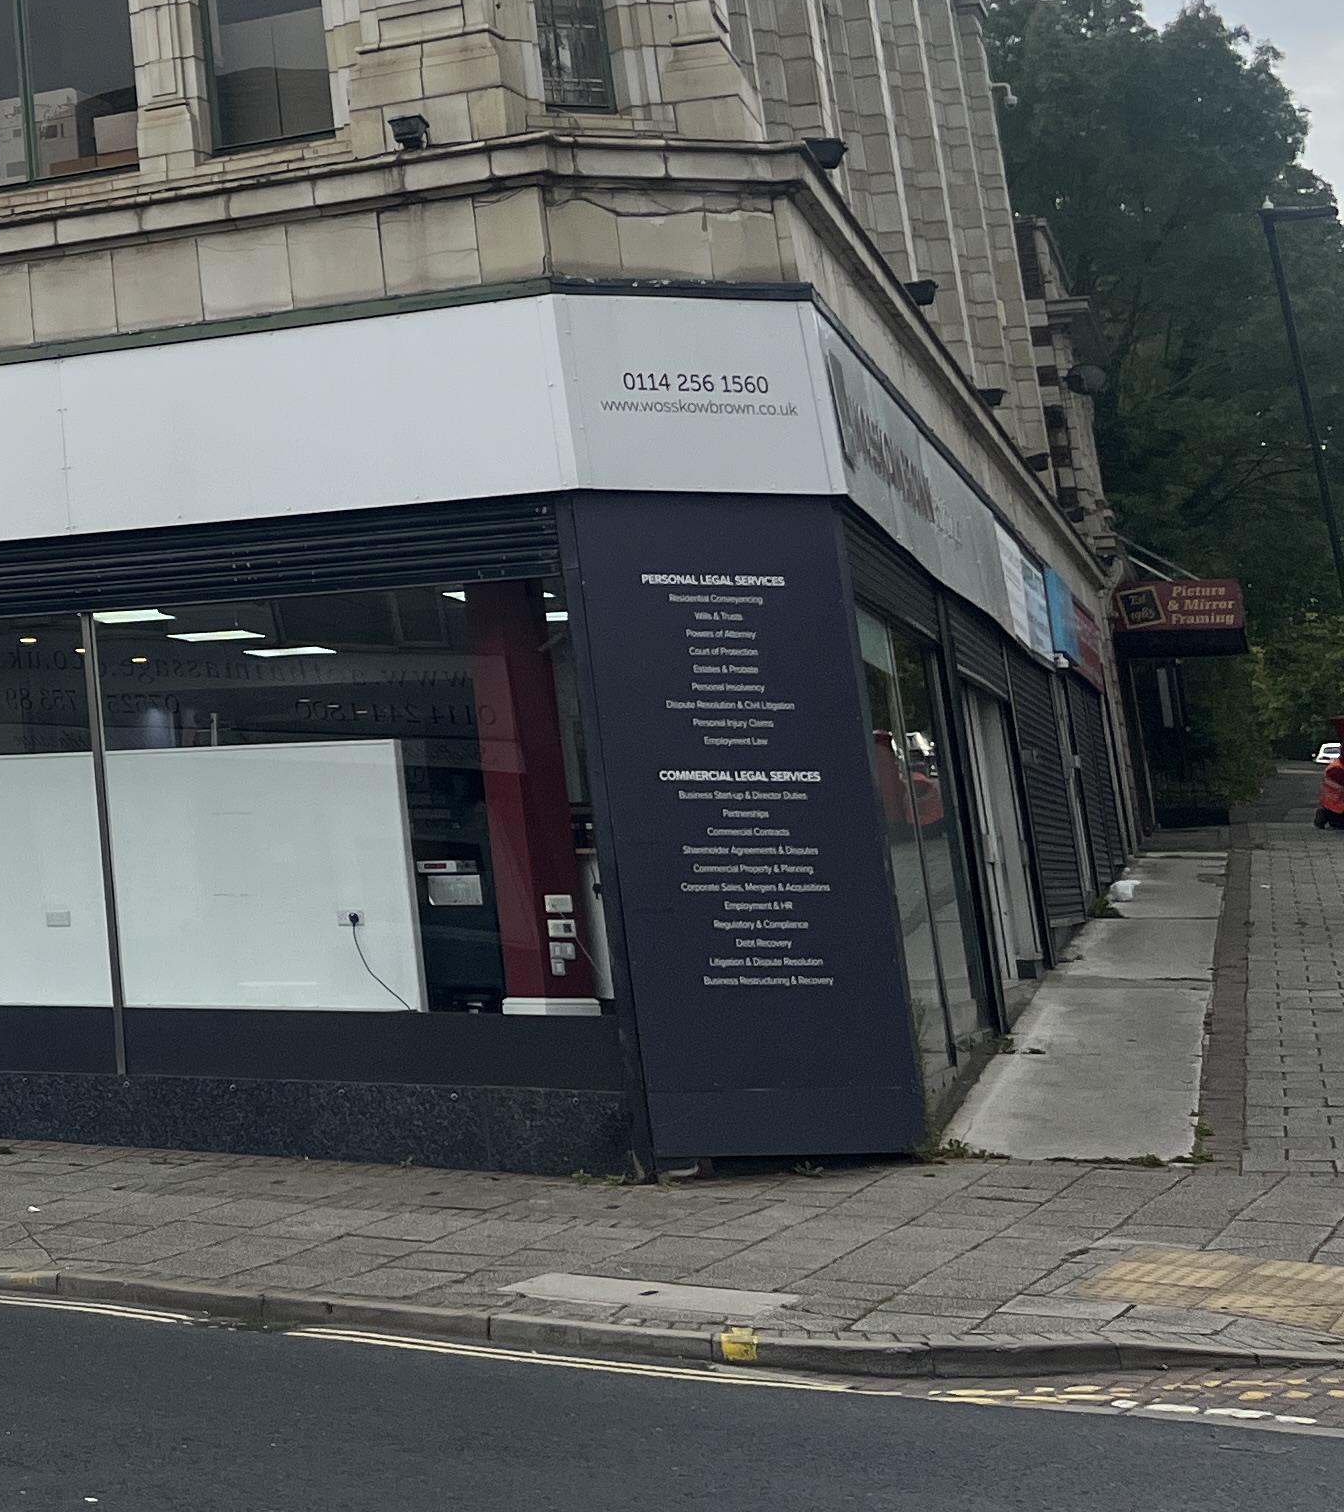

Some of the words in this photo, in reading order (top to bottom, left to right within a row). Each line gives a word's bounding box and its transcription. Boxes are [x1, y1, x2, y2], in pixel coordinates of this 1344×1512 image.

[623, 372, 671, 391] 0114
[676, 374, 714, 392] 256
[720, 375, 769, 393] 1560
[600, 399, 798, 416] www.wosskowbrown.co.uk
[641, 574, 698, 585] PERSONAL
[700, 575, 734, 585] LEGAL
[734, 575, 786, 586] SERVICES
[1172, 586, 1226, 597] Picture
[1167, 599, 1179, 611] &
[1184, 598, 1236, 610] Mirror
[1172, 612, 1235, 625] Framing
[659, 770, 733, 781] COMMERCIAL
[734, 771, 769, 782] LEGAL
[770, 771, 821, 782] SERVICES
